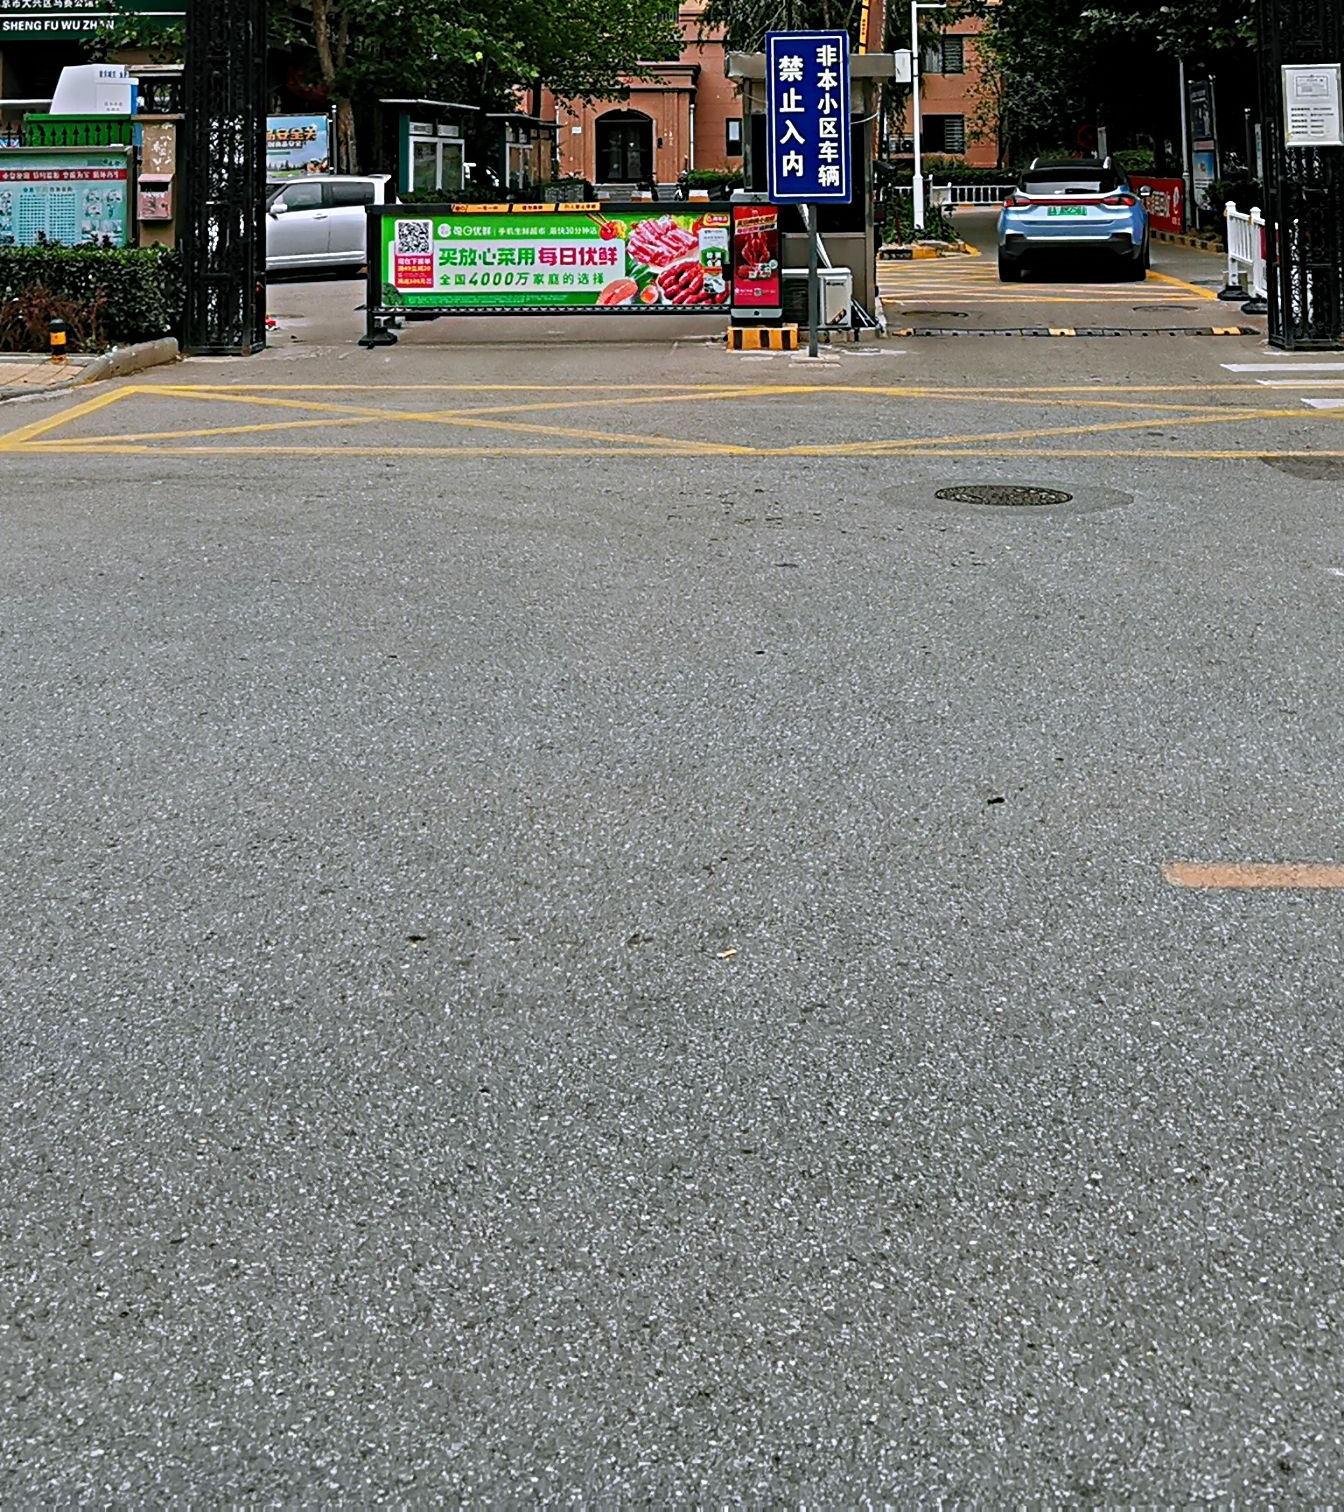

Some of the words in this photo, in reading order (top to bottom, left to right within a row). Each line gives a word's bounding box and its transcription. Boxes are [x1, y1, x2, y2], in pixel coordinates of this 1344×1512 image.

[2, 20, 42, 31] SHENG
[44, 20, 58, 30] FU
[61, 20, 81, 30] WU
[778, 55, 805, 177] 禁止入内
[816, 44, 840, 187] 非本小区车辆
[440, 272, 605, 287] 全国4000万家庭的选择
